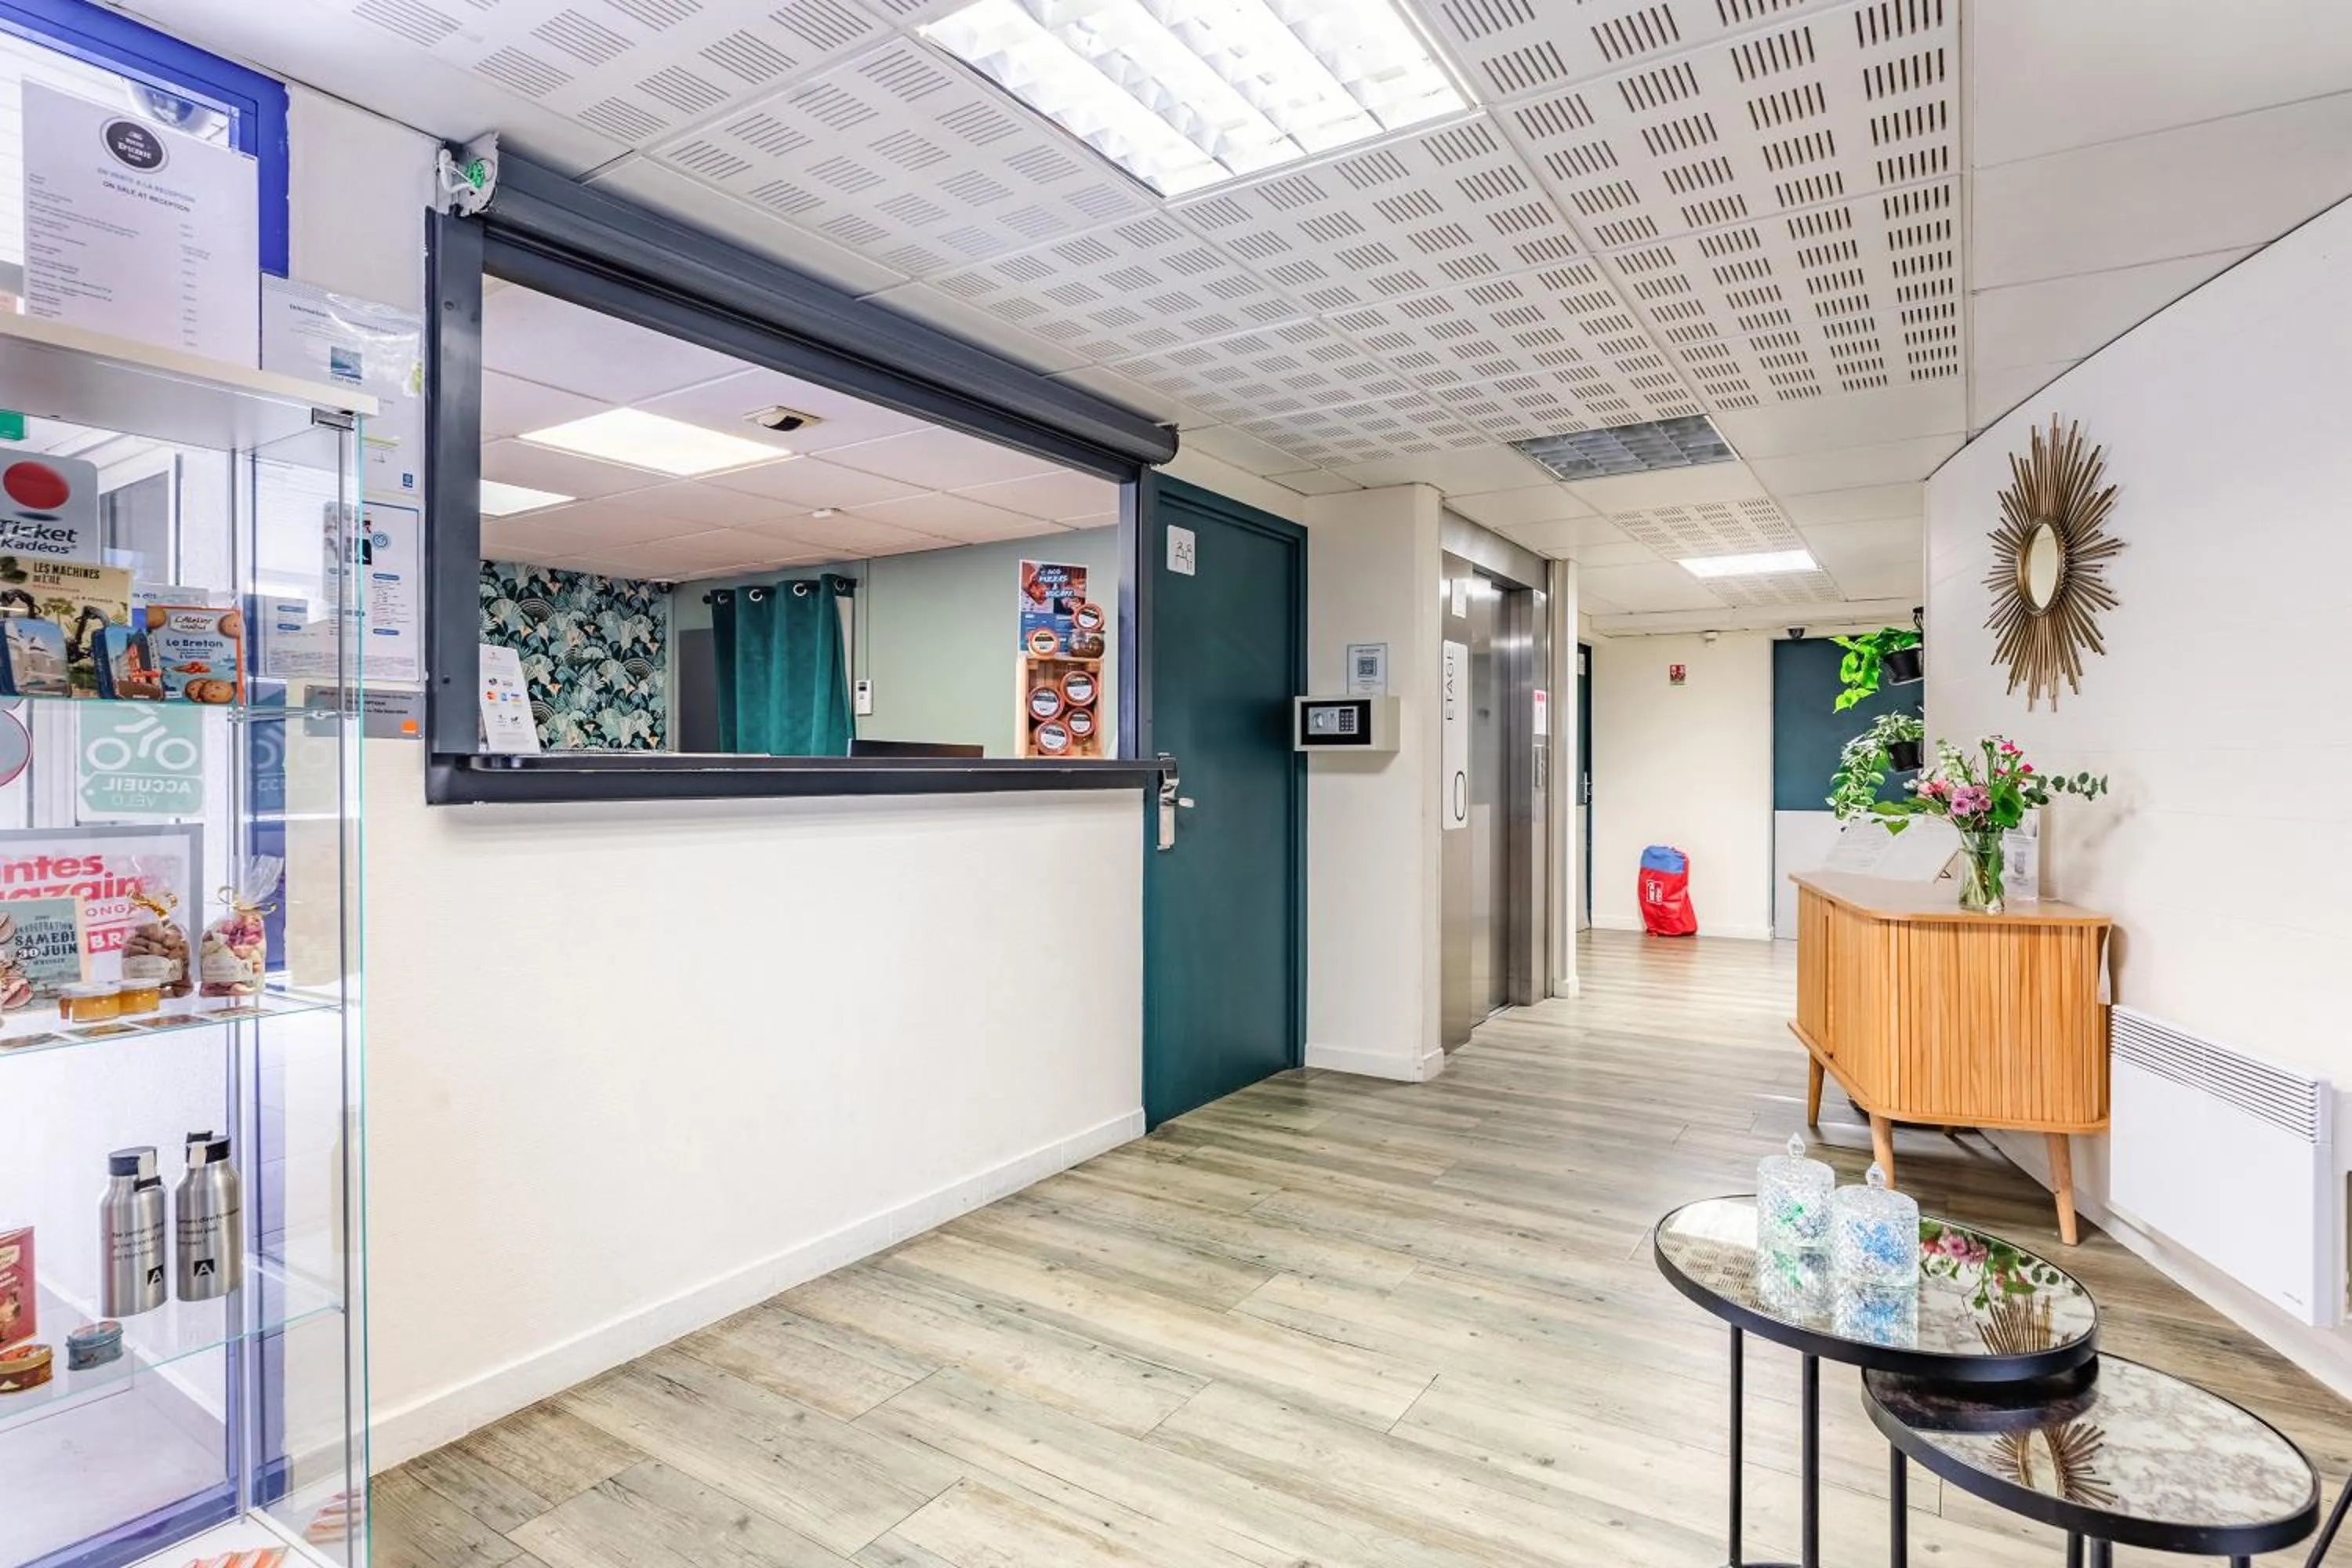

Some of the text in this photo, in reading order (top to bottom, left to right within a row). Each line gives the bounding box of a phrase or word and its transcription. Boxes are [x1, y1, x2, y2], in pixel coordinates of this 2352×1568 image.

[0, 518, 78, 543] Ticket
[1, 538, 70, 554] Kadéos
[34, 561, 100, 579] LES MACHINES
[182, 639, 224, 648] Breton
[3, 855, 103, 884] ntes
[15, 931, 76, 946] SAMEDI
[89, 931, 123, 950] BR
[42, 942, 78, 956] JUIN
